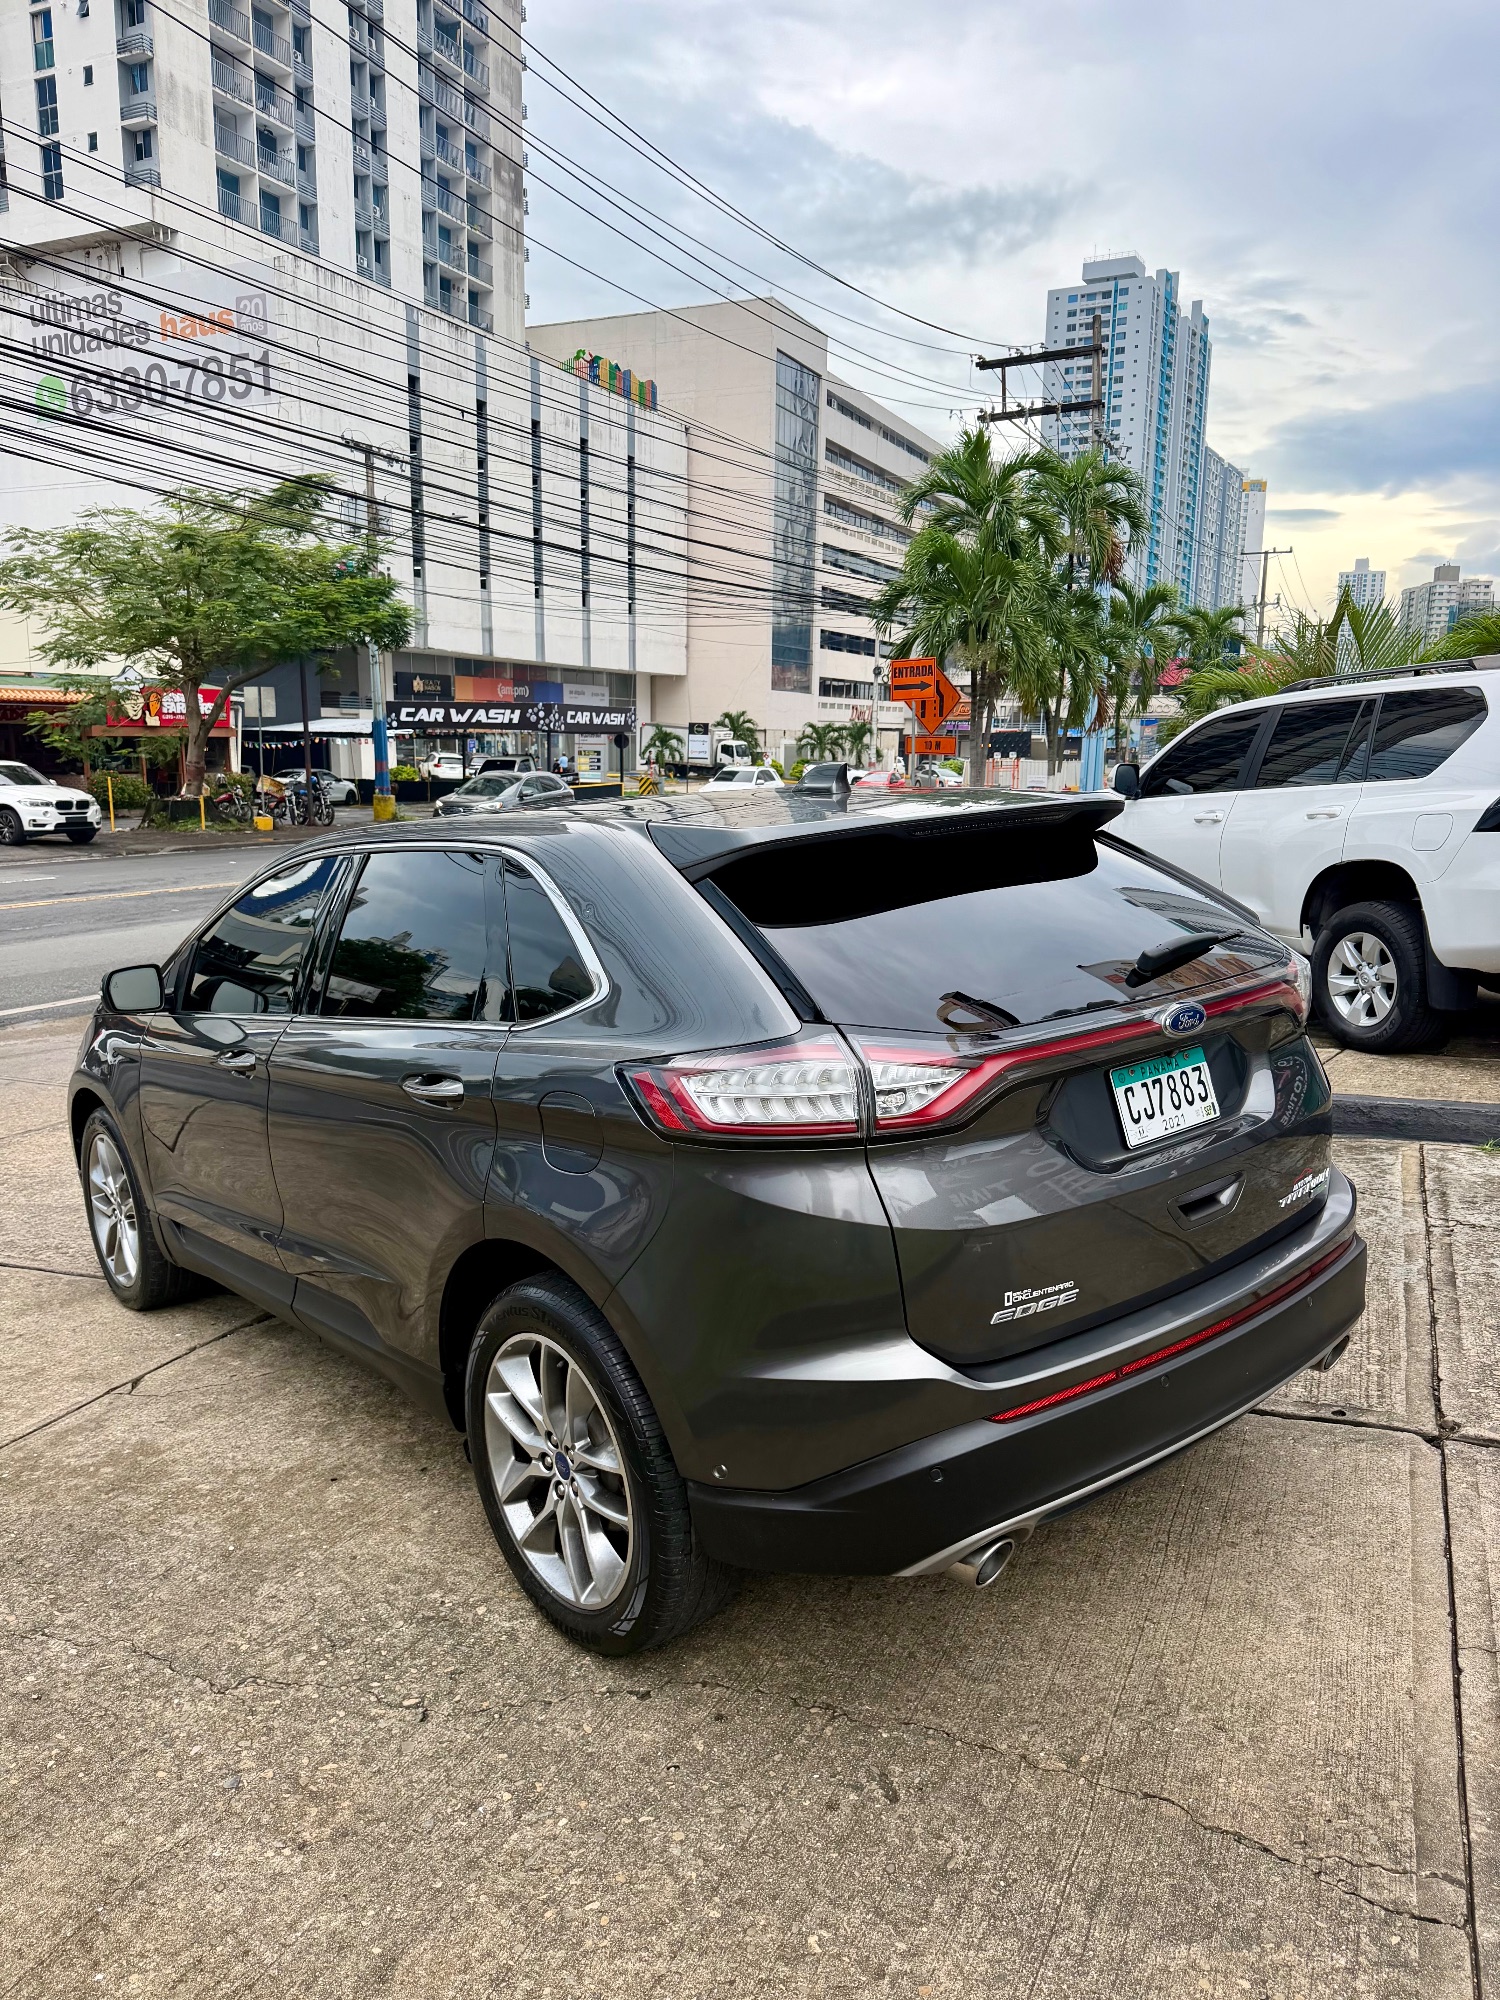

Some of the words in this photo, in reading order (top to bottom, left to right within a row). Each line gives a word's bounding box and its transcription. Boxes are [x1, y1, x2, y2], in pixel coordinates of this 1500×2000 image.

[240, 297, 264, 323] 20
[160, 309, 235, 342] haus
[240, 319, 264, 333] años
[31, 317, 150, 358] unidades
[893, 664, 934, 679] ENTRADA
[400, 707, 445, 722] CAR
[449, 708, 521, 724] WASH
[566, 710, 591, 724] CAR
[592, 711, 626, 726] WASH
[934, 740, 941, 750] M
[1178, 1011, 1200, 1030] Ford
[1139, 1058, 1179, 1078] PANAMA
[1123, 1065, 1209, 1125] CJ7883
[1162, 1113, 1187, 1131] 2021
[990, 1289, 1080, 1325] EDGE
